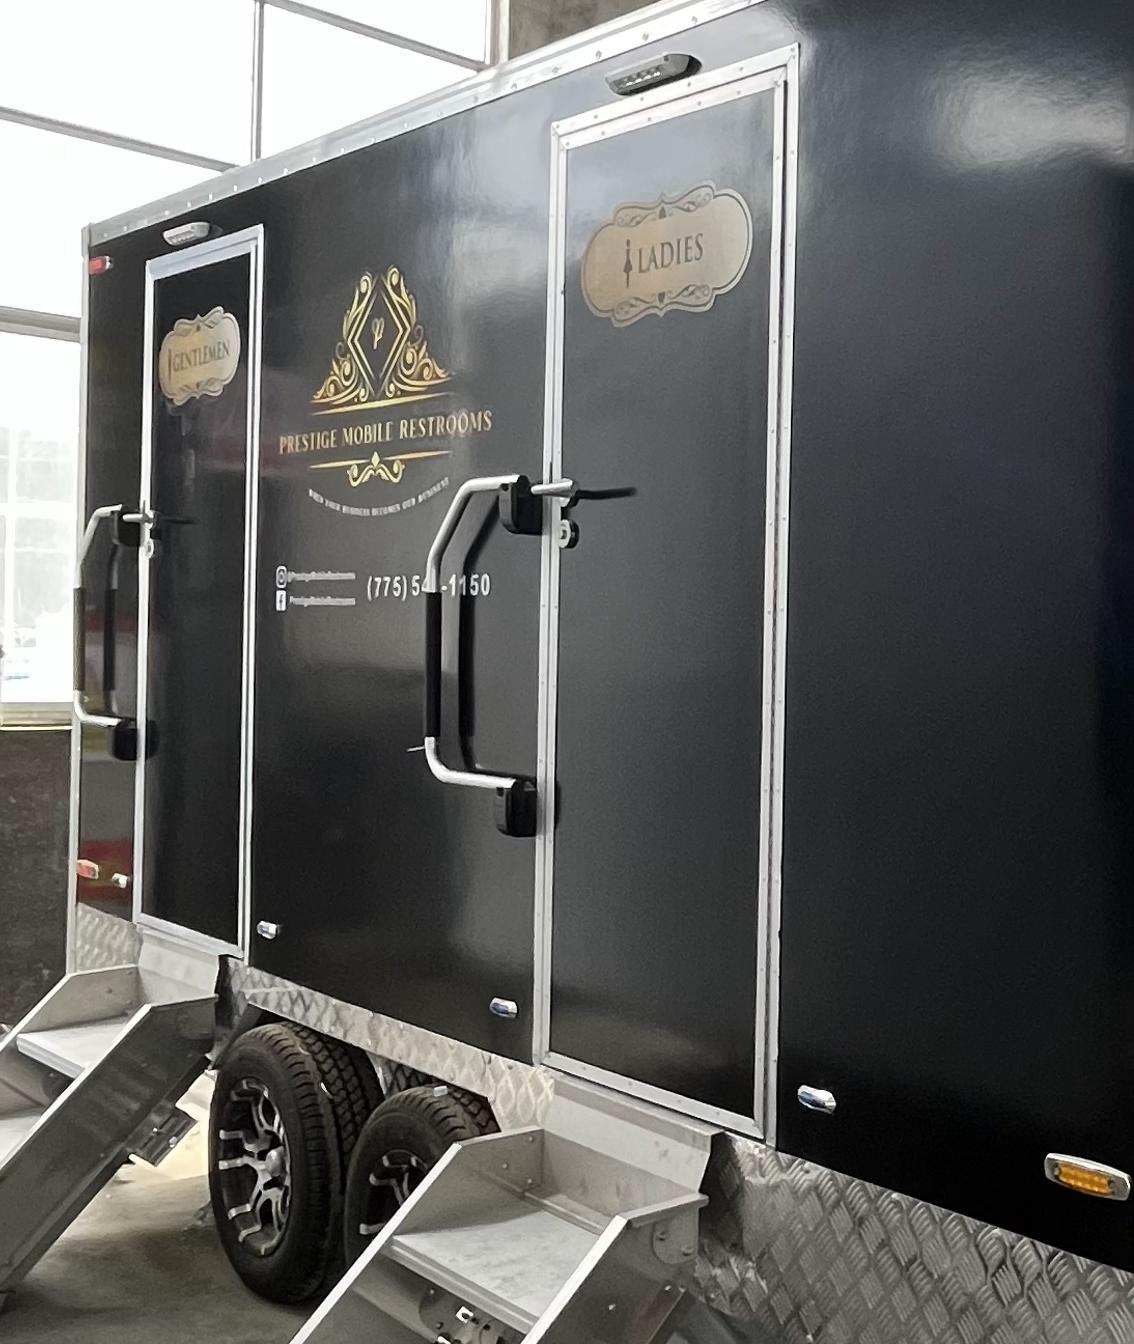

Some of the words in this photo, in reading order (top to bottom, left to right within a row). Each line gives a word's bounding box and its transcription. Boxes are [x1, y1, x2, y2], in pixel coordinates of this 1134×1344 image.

[637, 232, 704, 274] LADIES
[172, 339, 231, 373] GENTLEMEN
[279, 429, 338, 455] PRESTIGE
[342, 420, 394, 447] MOBILE
[399, 409, 493, 439] RESTROOMS
